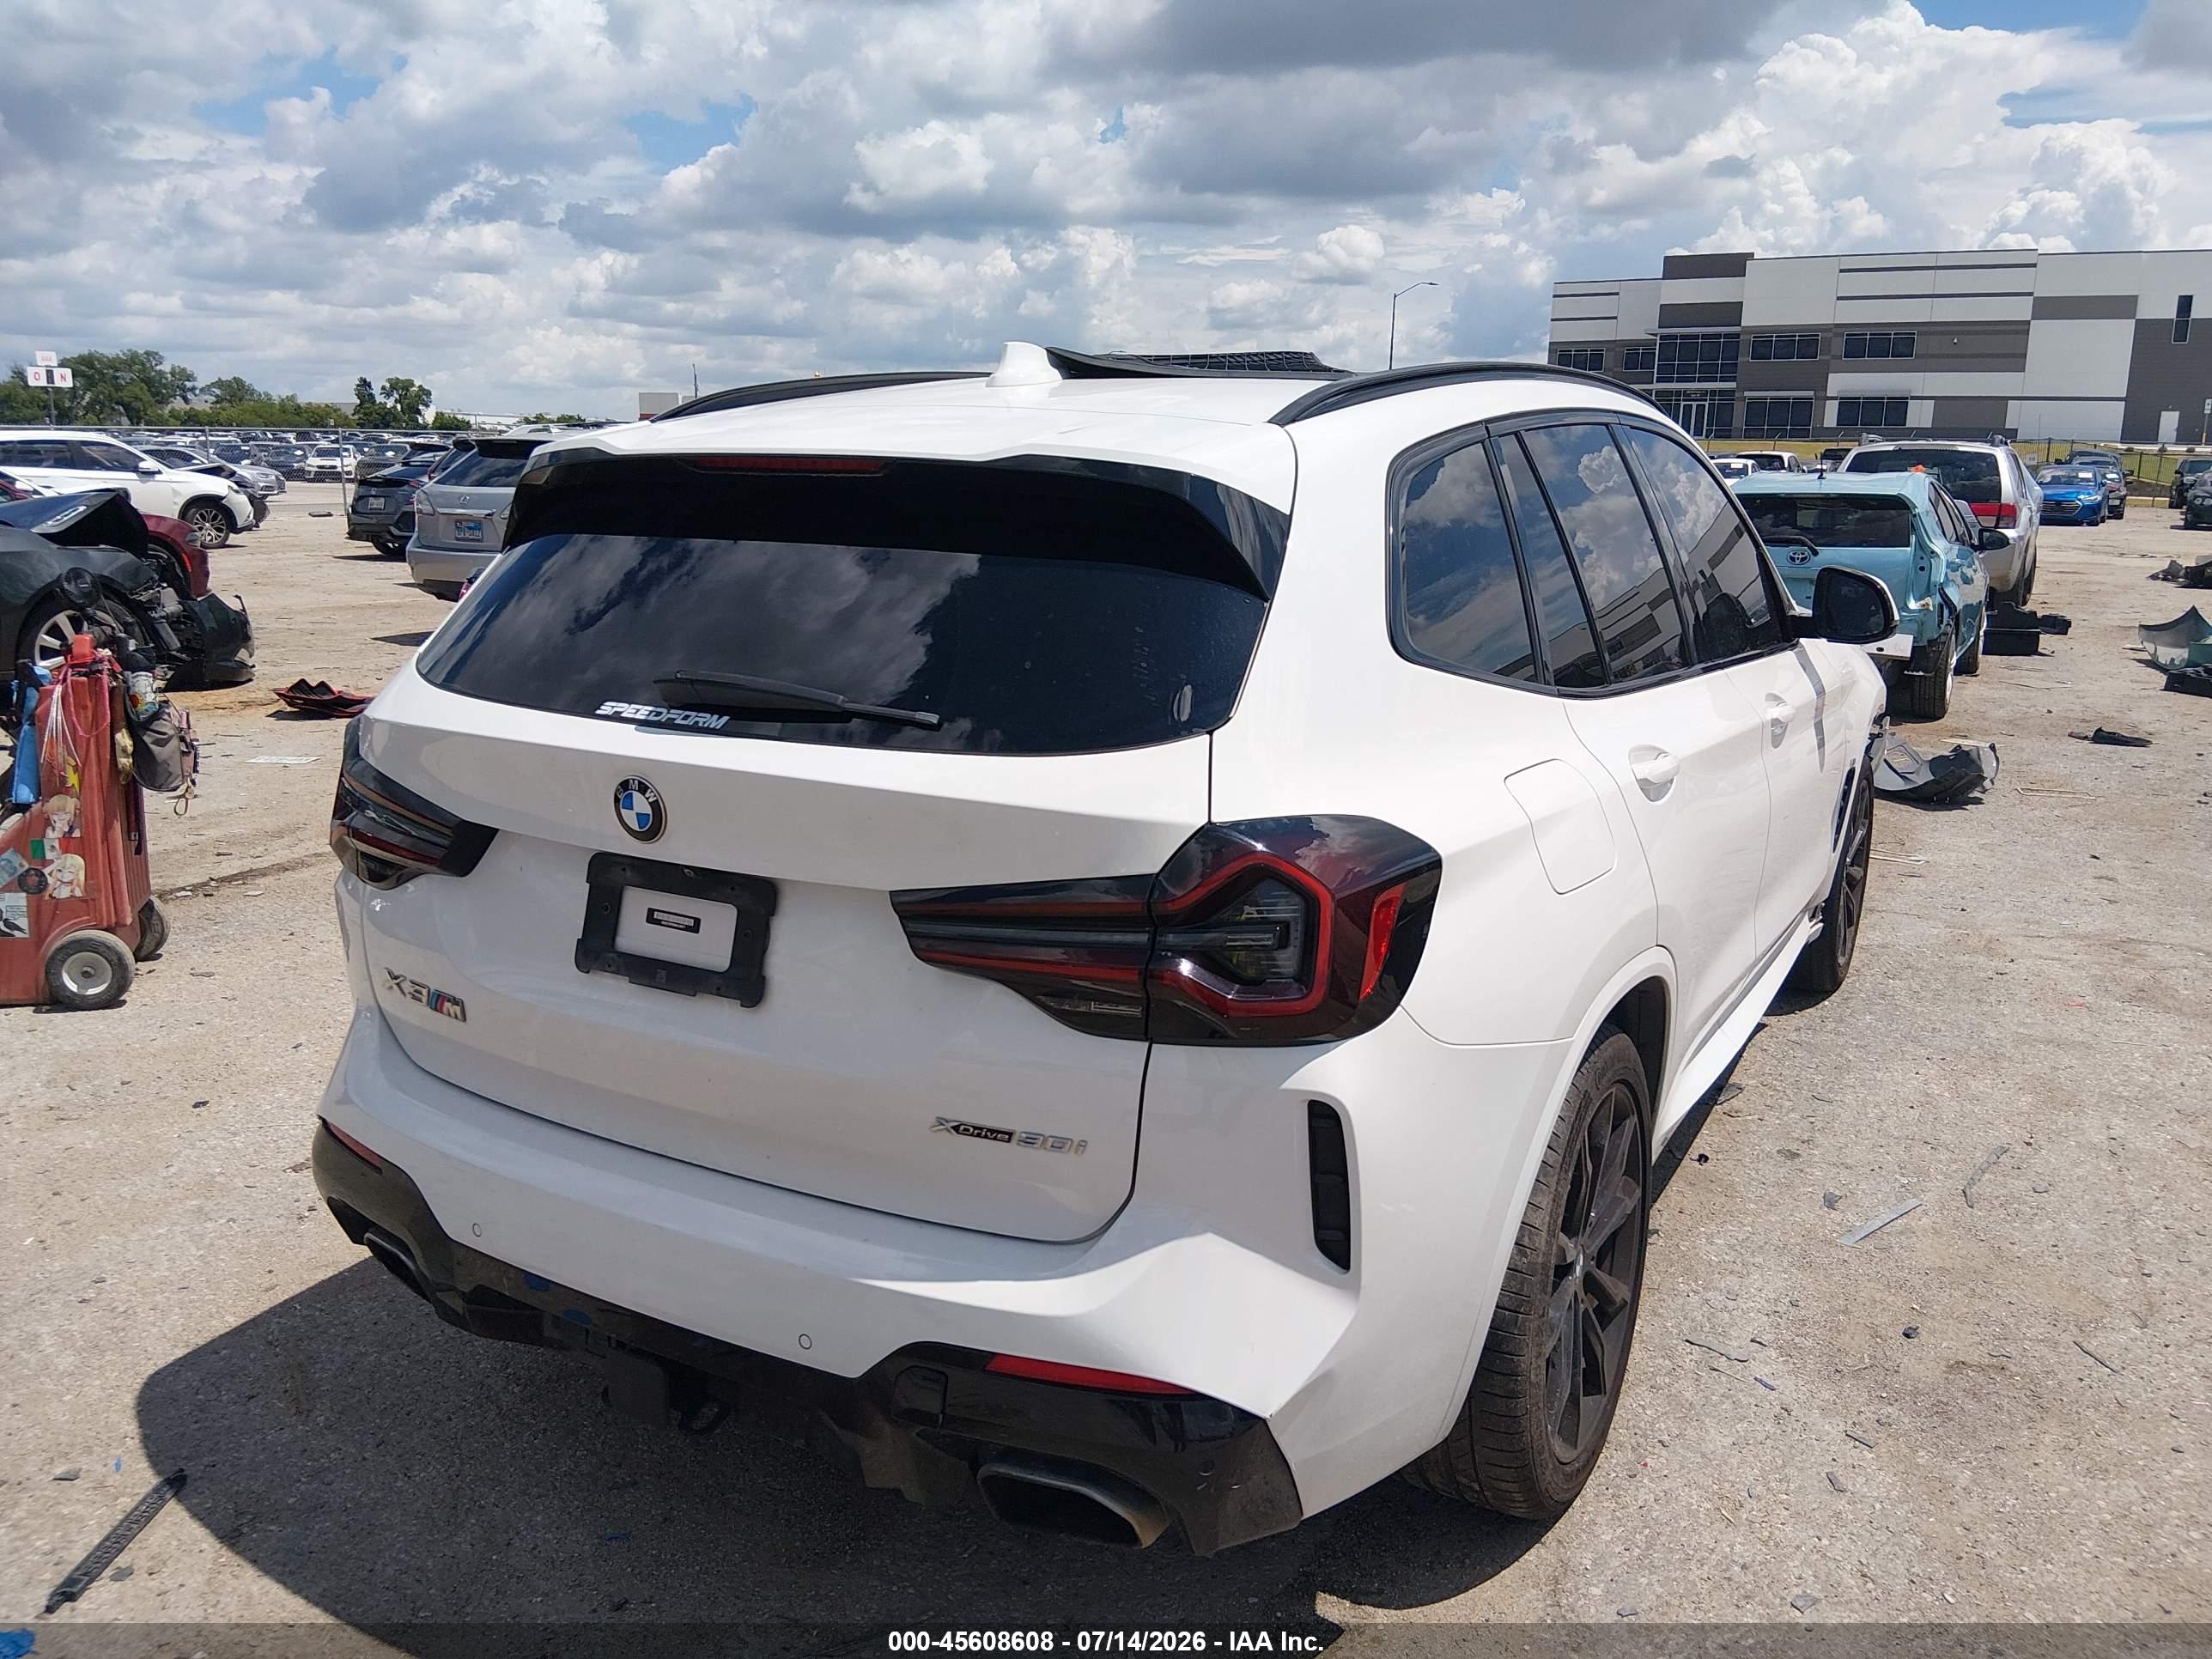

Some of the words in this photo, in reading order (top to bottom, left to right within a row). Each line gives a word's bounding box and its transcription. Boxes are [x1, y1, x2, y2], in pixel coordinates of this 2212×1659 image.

[59, 372, 67, 383] N
[594, 701, 730, 730] SPEEDFORM
[616, 779, 658, 803] BMW
[1017, 1130, 1088, 1155] 30i
